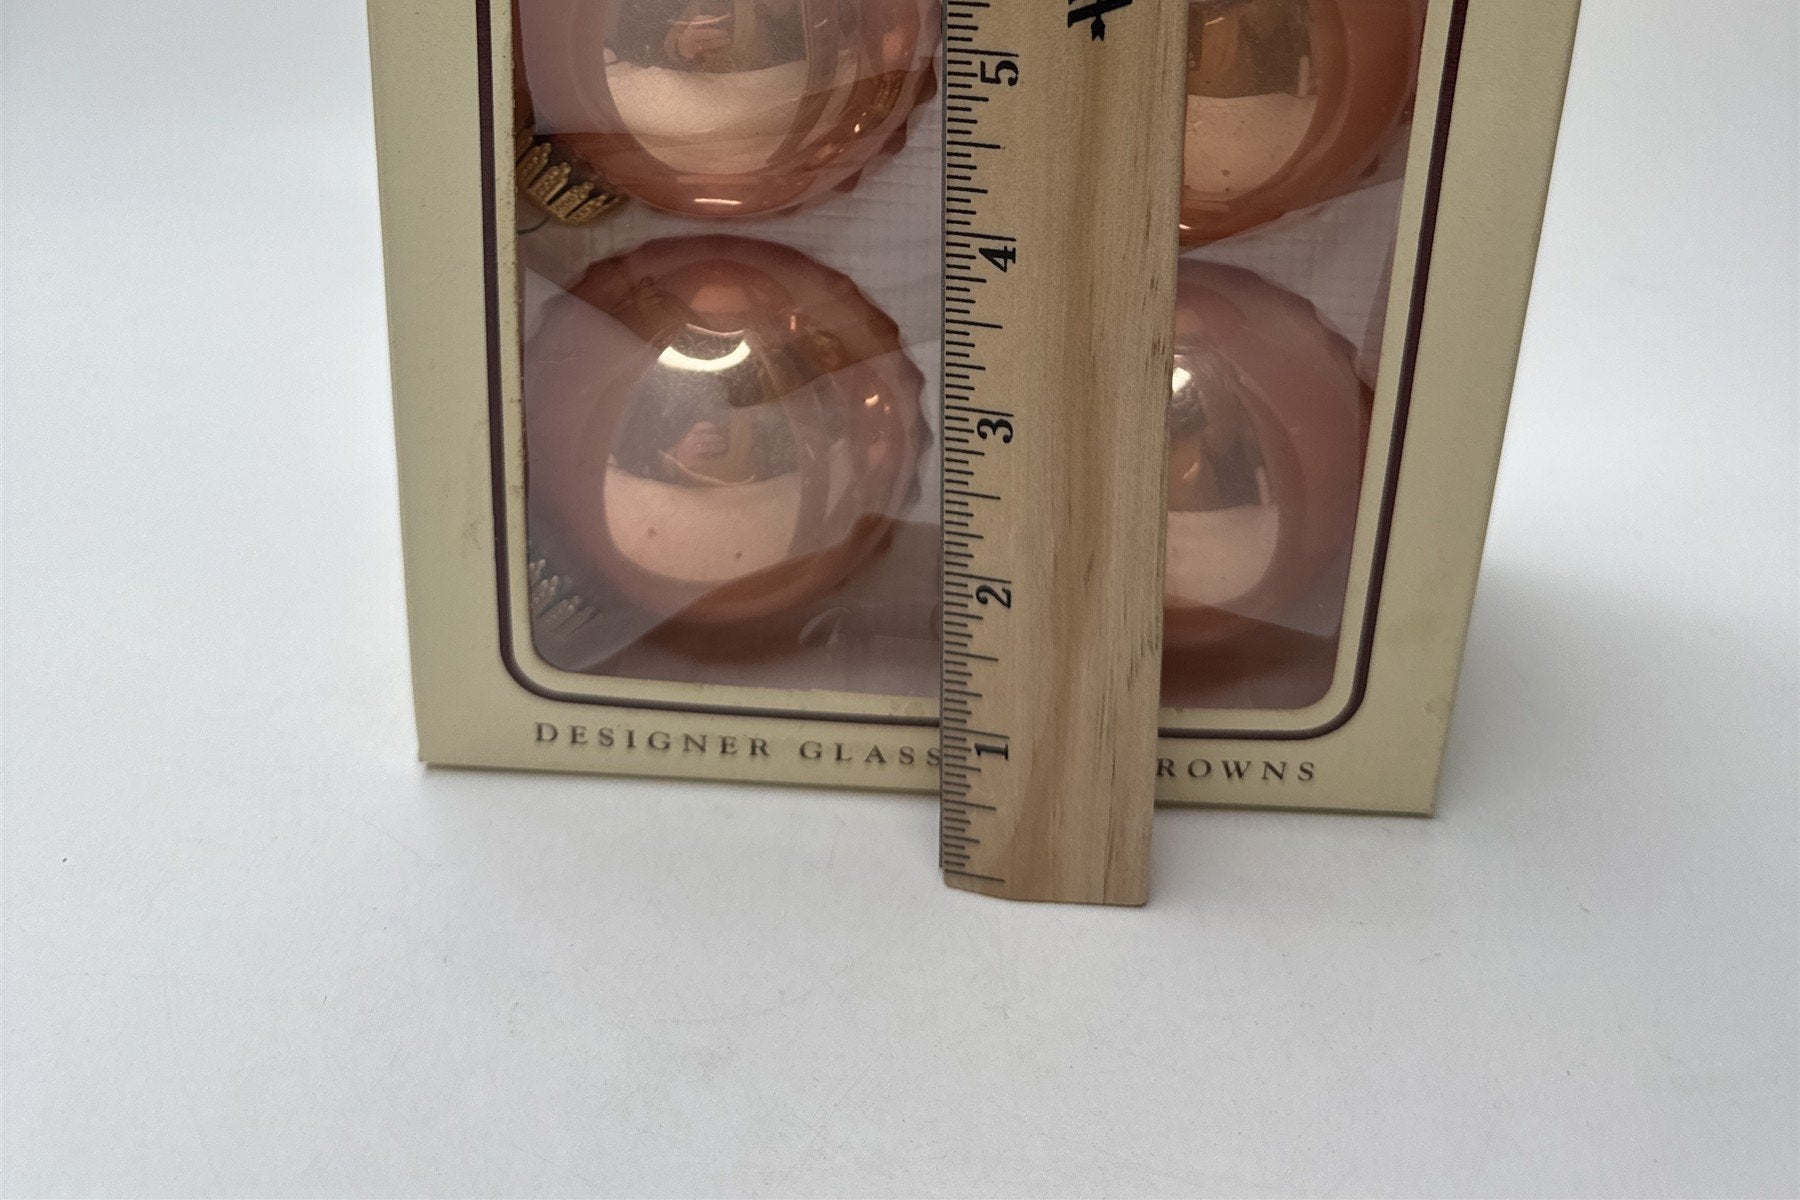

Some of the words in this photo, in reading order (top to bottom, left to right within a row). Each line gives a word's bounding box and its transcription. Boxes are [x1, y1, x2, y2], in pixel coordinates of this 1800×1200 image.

[980, 59, 1020, 87] 5
[978, 245, 1017, 273] 4
[976, 417, 1014, 444] 3
[975, 584, 1012, 609] 2
[534, 720, 771, 758] DESIGNER
[799, 740, 941, 766] GLASS
[1156, 757, 1315, 782] ROWNS
[974, 742, 1010, 761] 1
